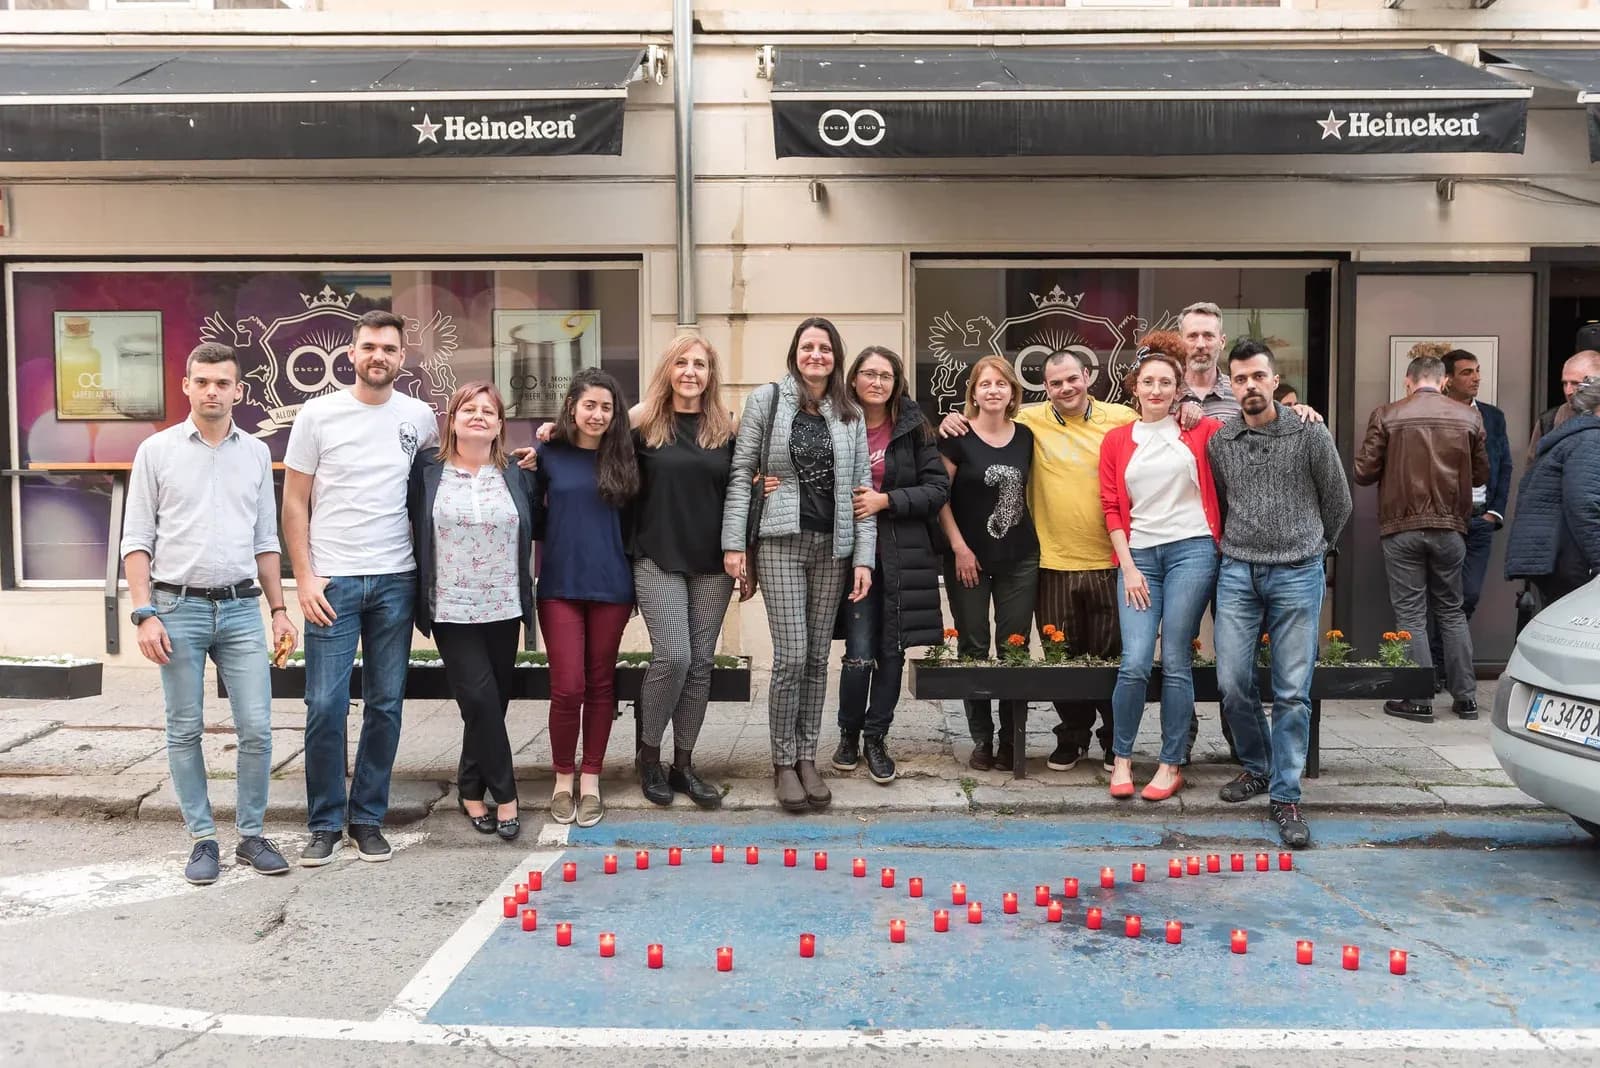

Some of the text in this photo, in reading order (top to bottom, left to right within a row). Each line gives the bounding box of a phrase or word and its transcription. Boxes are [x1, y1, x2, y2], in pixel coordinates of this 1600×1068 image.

[443, 114, 577, 141] Heineken
[1348, 111, 1480, 137] Heineken
[275, 409, 298, 420] ALLOW
